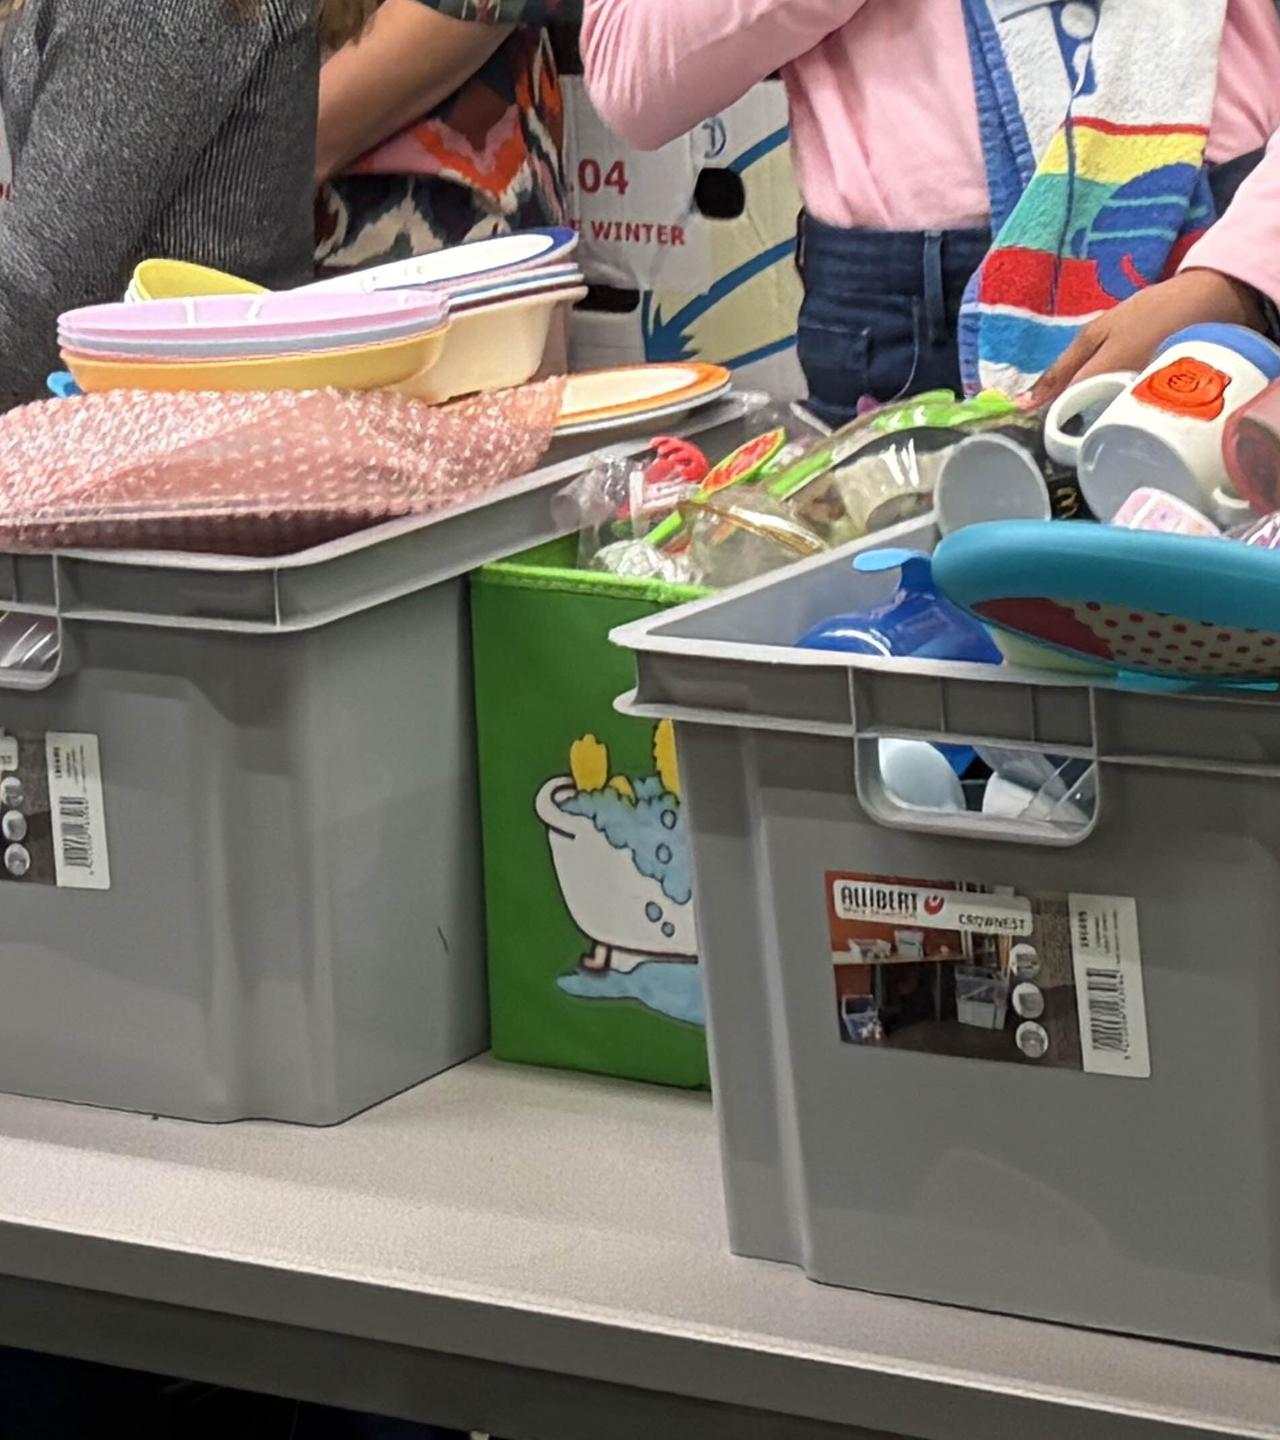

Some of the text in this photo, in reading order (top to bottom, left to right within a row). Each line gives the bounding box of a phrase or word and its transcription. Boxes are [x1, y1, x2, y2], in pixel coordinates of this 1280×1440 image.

[568, 158, 630, 199] 04
[590, 218, 686, 247] WINTER
[840, 886, 919, 913] ALLIBERT
[958, 912, 1026, 931] CROWNEST
